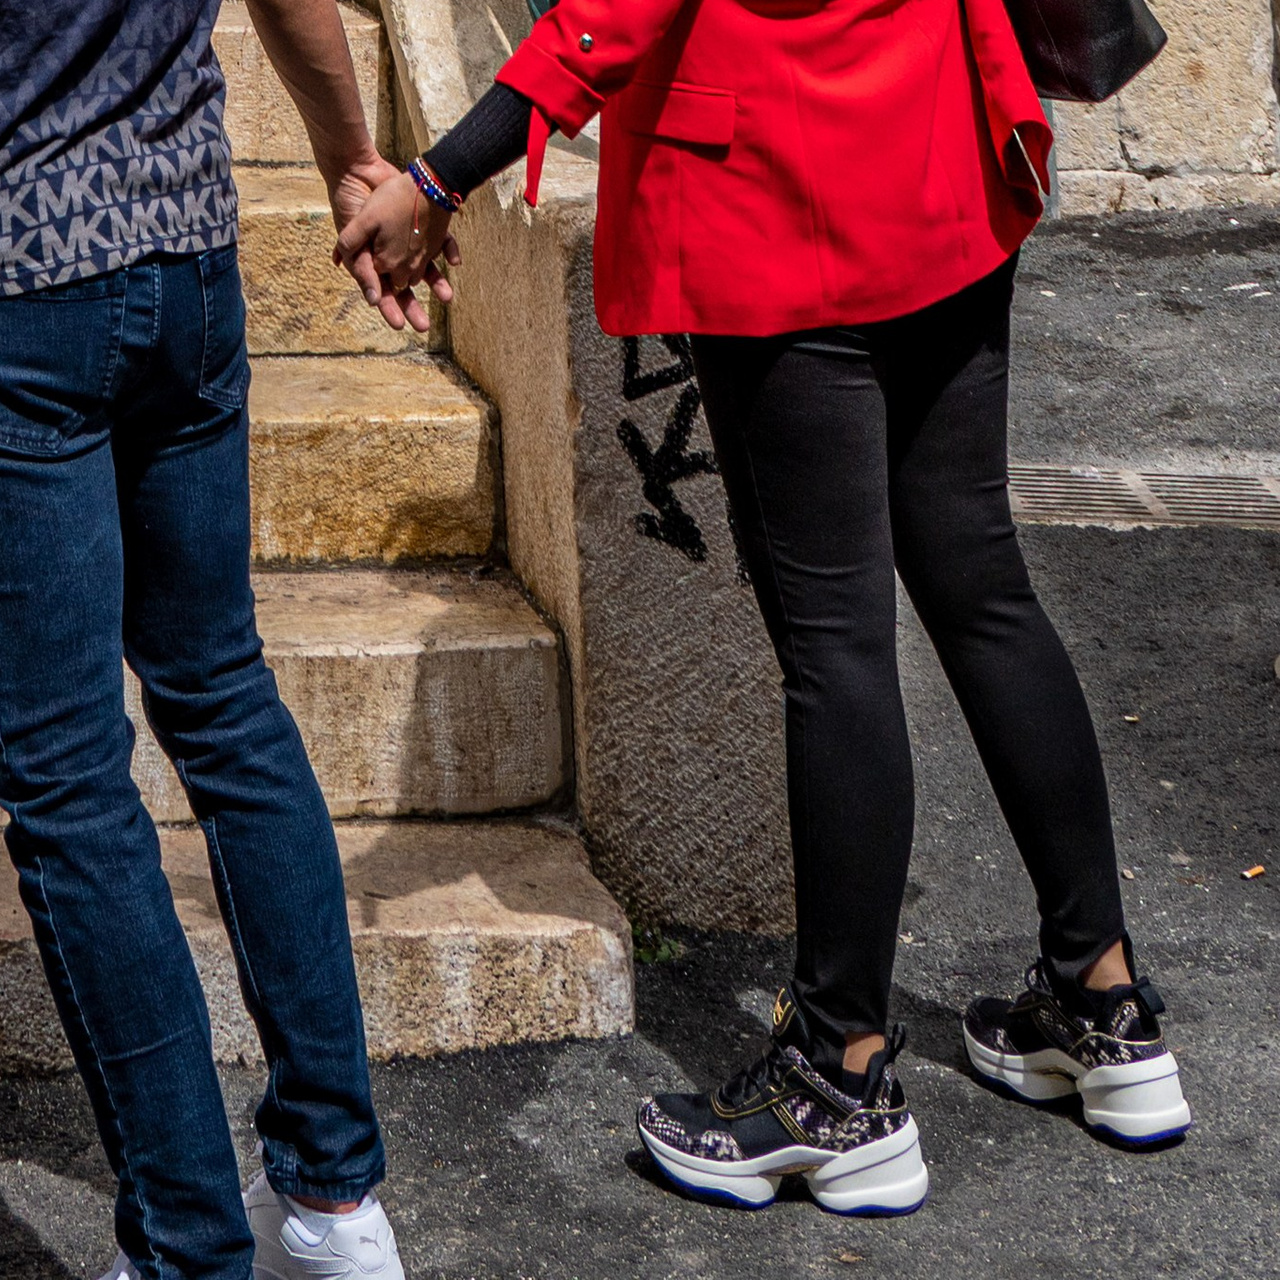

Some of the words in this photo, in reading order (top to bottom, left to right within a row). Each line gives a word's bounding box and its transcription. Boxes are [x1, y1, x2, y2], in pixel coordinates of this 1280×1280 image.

[36, 164, 106, 223] MK
[101, 155, 162, 206] MK
[155, 142, 213, 196] MK
[108, 195, 171, 248] MK
[161, 185, 220, 239] MK
